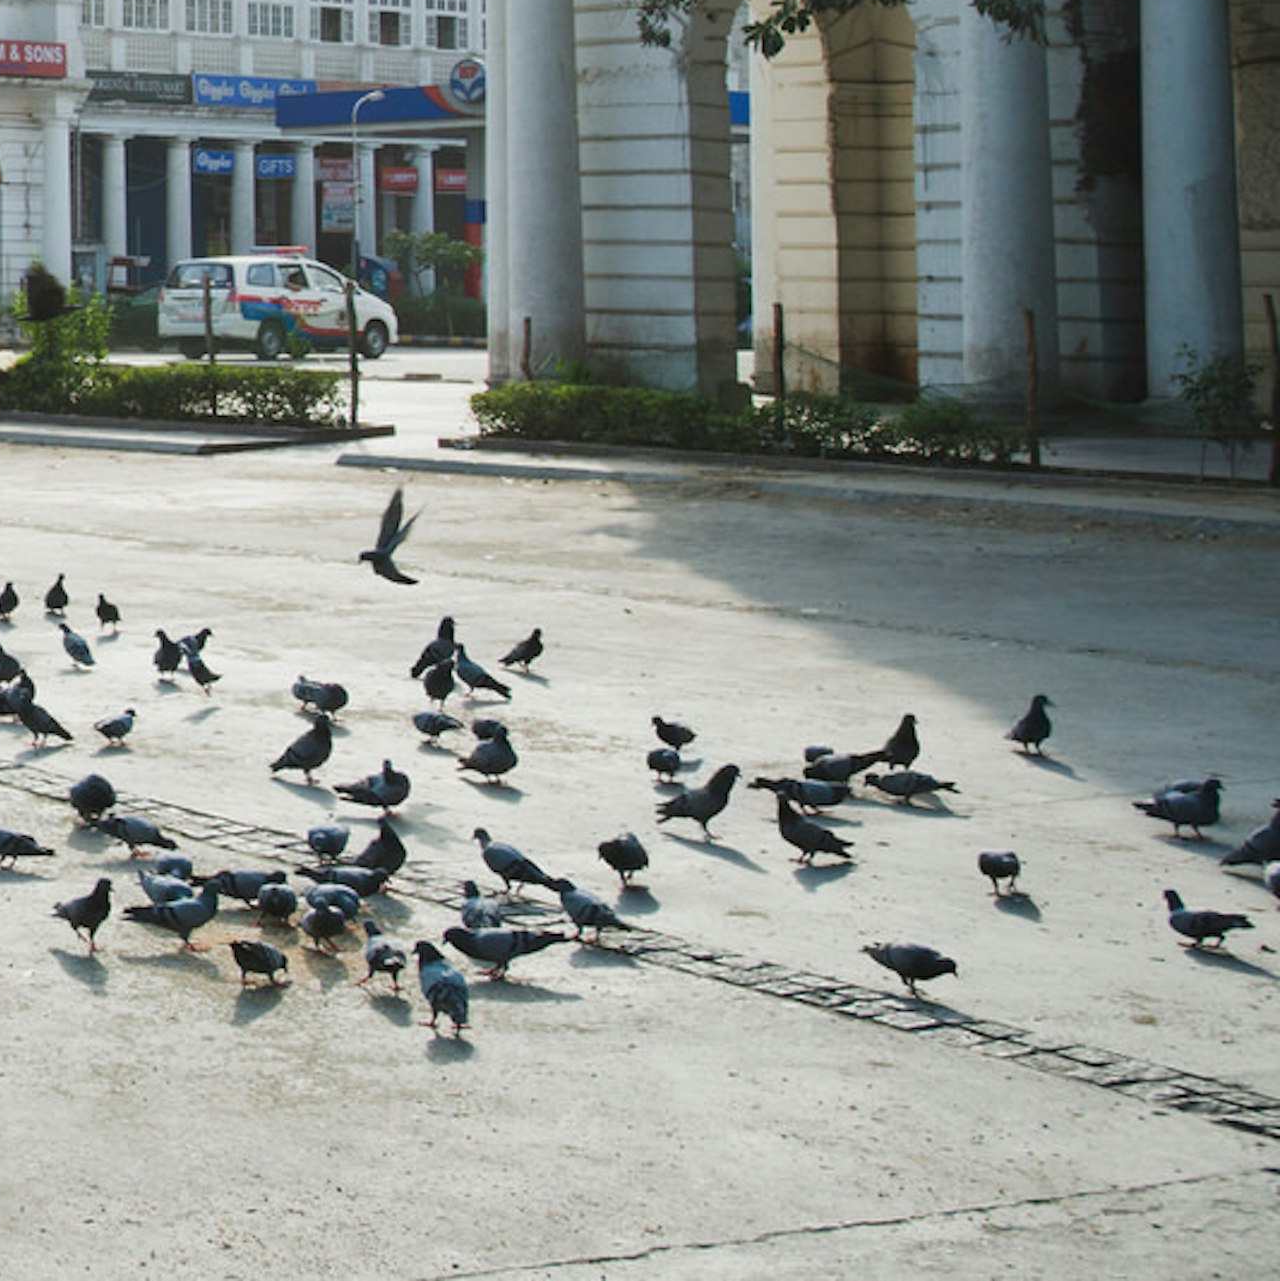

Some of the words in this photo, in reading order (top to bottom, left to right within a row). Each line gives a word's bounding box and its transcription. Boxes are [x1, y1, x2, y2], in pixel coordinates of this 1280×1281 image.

[9, 43, 20, 61] &
[23, 44, 64, 64] SONS
[259, 159, 294, 174] GIFTS
